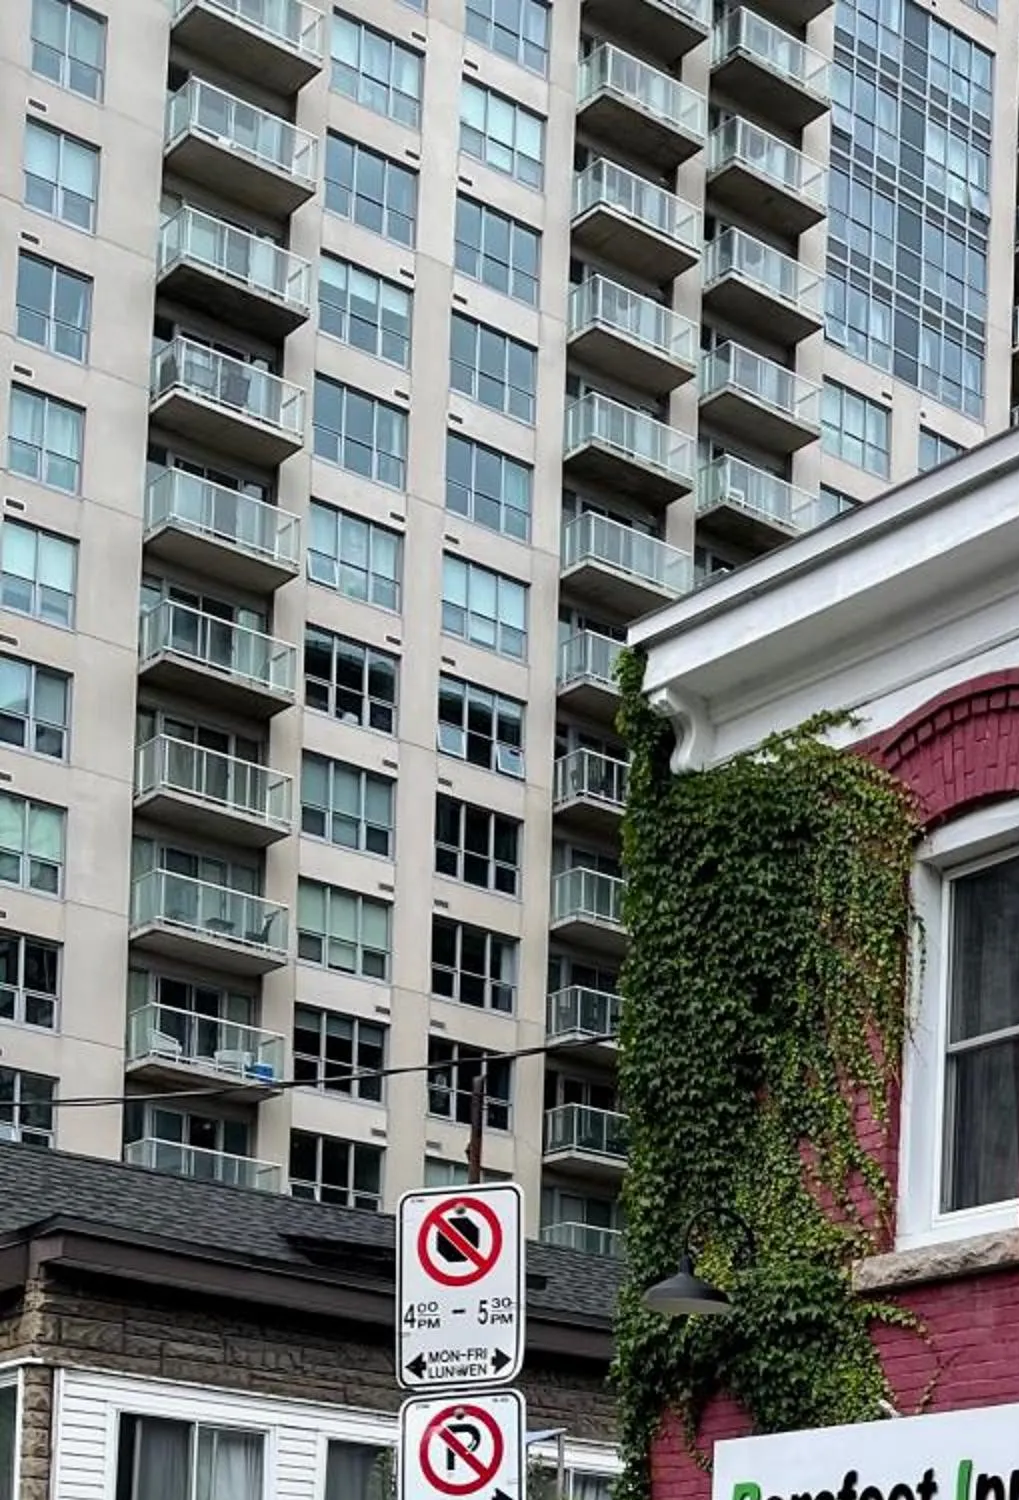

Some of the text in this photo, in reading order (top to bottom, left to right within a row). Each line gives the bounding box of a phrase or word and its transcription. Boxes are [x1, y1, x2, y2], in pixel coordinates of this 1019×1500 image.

[417, 1313, 513, 1329] PM PM
[428, 1347, 488, 1363] MON-FRI
